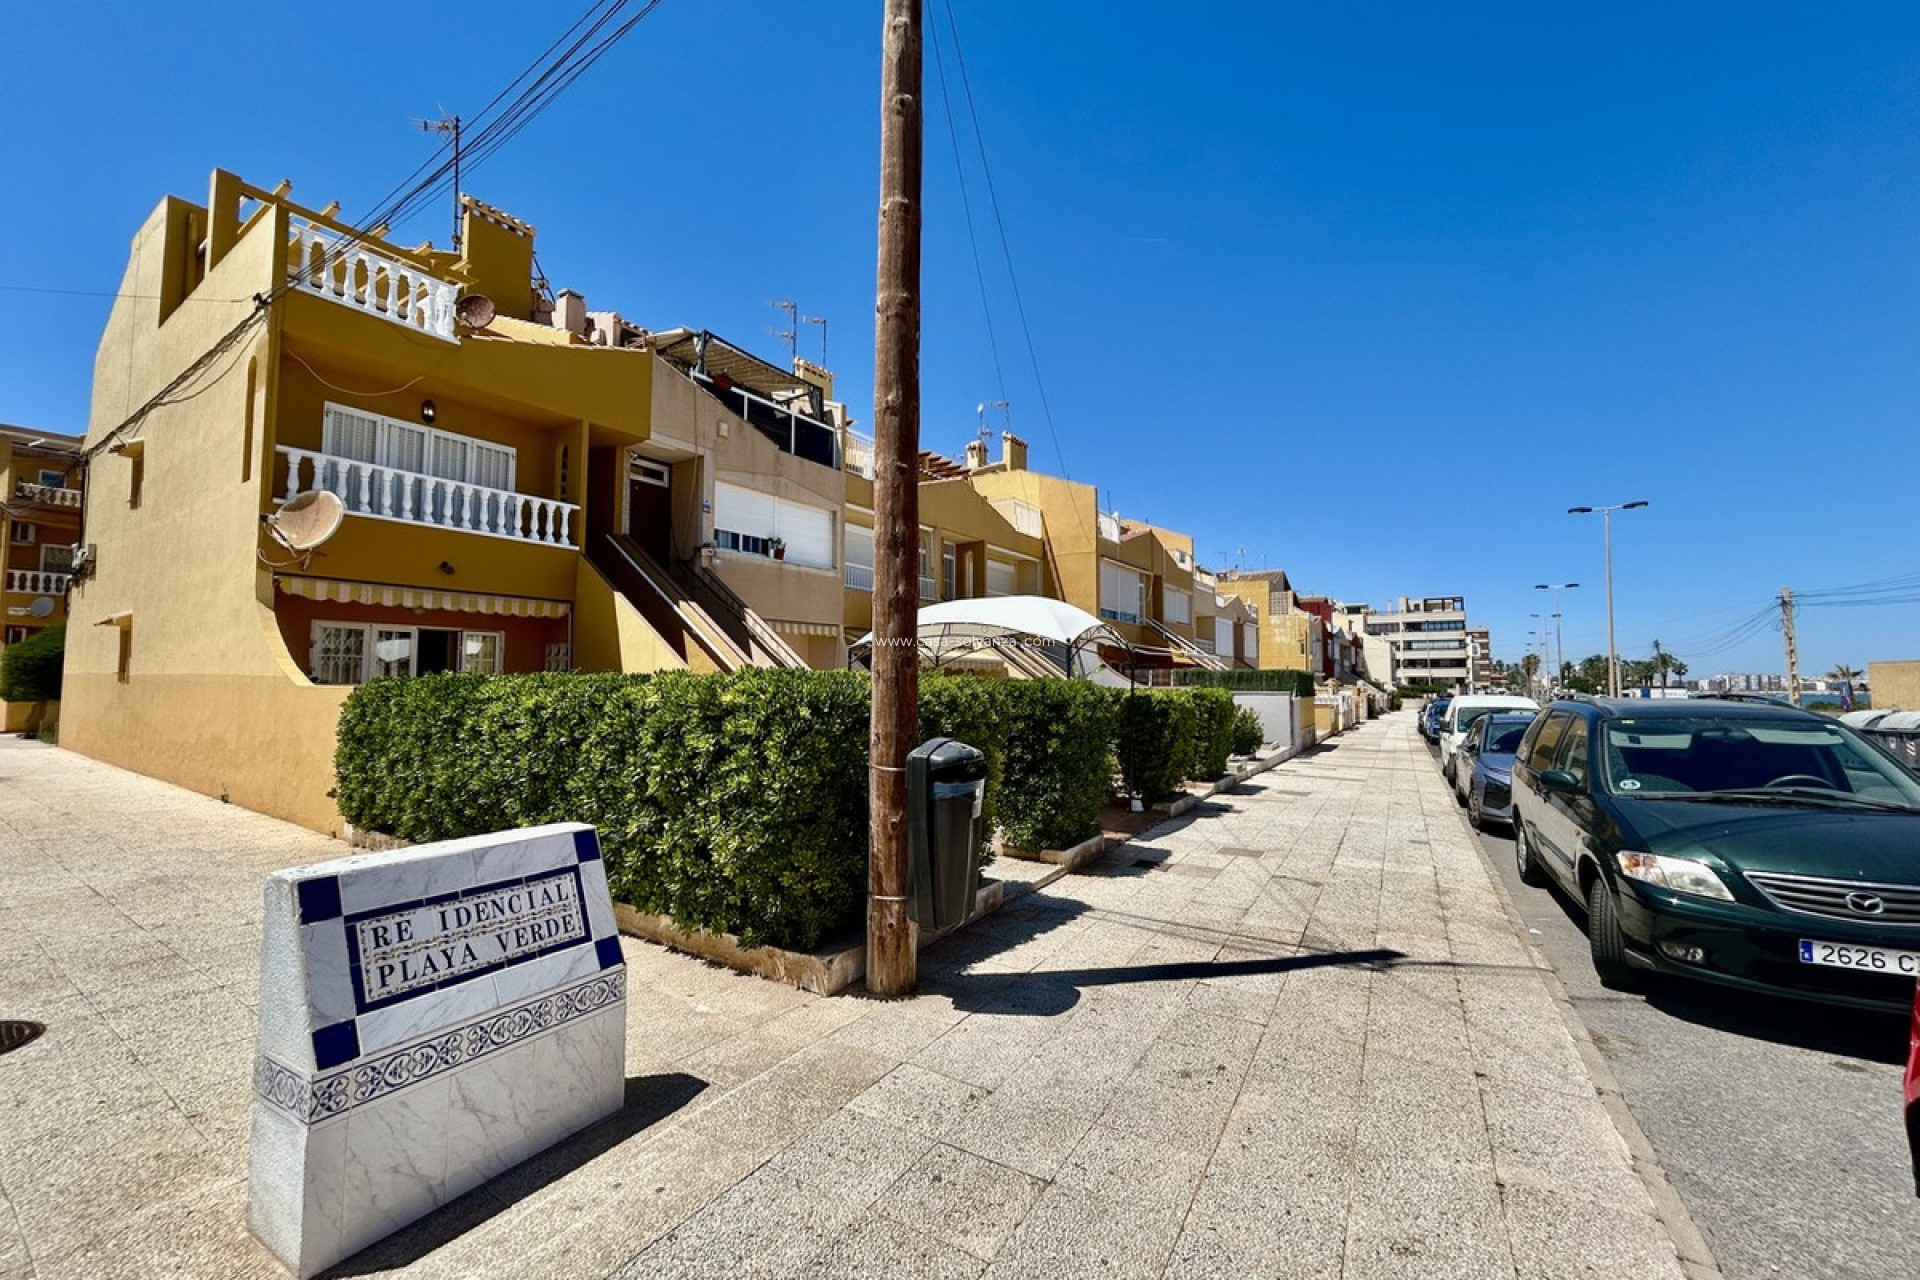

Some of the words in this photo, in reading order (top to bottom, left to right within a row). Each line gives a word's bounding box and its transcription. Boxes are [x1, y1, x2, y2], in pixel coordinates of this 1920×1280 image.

[378, 942, 478, 989] PLAYA
[495, 913, 576, 953] VERDE
[1821, 945, 1886, 969] 2626
